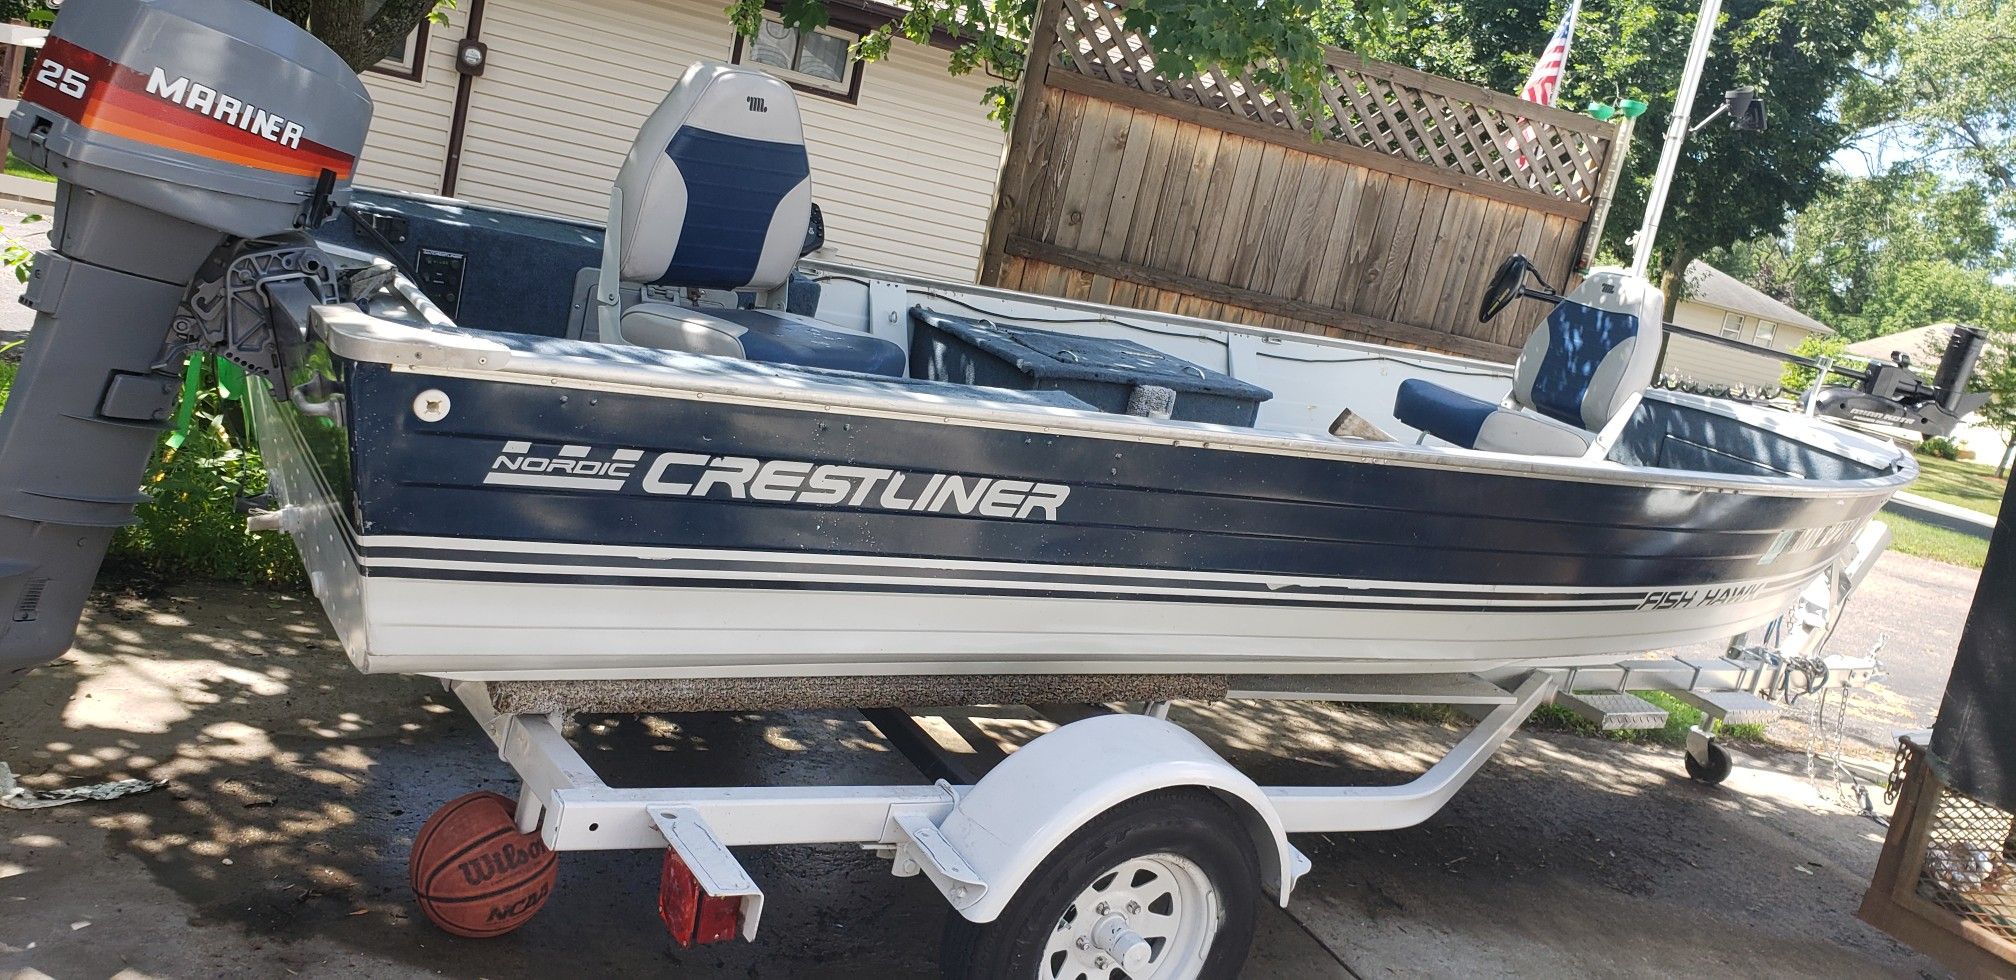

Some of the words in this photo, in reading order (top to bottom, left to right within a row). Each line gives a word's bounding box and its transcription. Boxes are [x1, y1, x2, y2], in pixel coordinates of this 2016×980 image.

[36, 59, 90, 100] 25
[146, 66, 305, 150] MARINER
[491, 455, 636, 477] NORDIC
[642, 452, 1070, 521] CRESTLINER
[1637, 590, 1698, 610] FISH
[1697, 582, 1765, 606] HAWK
